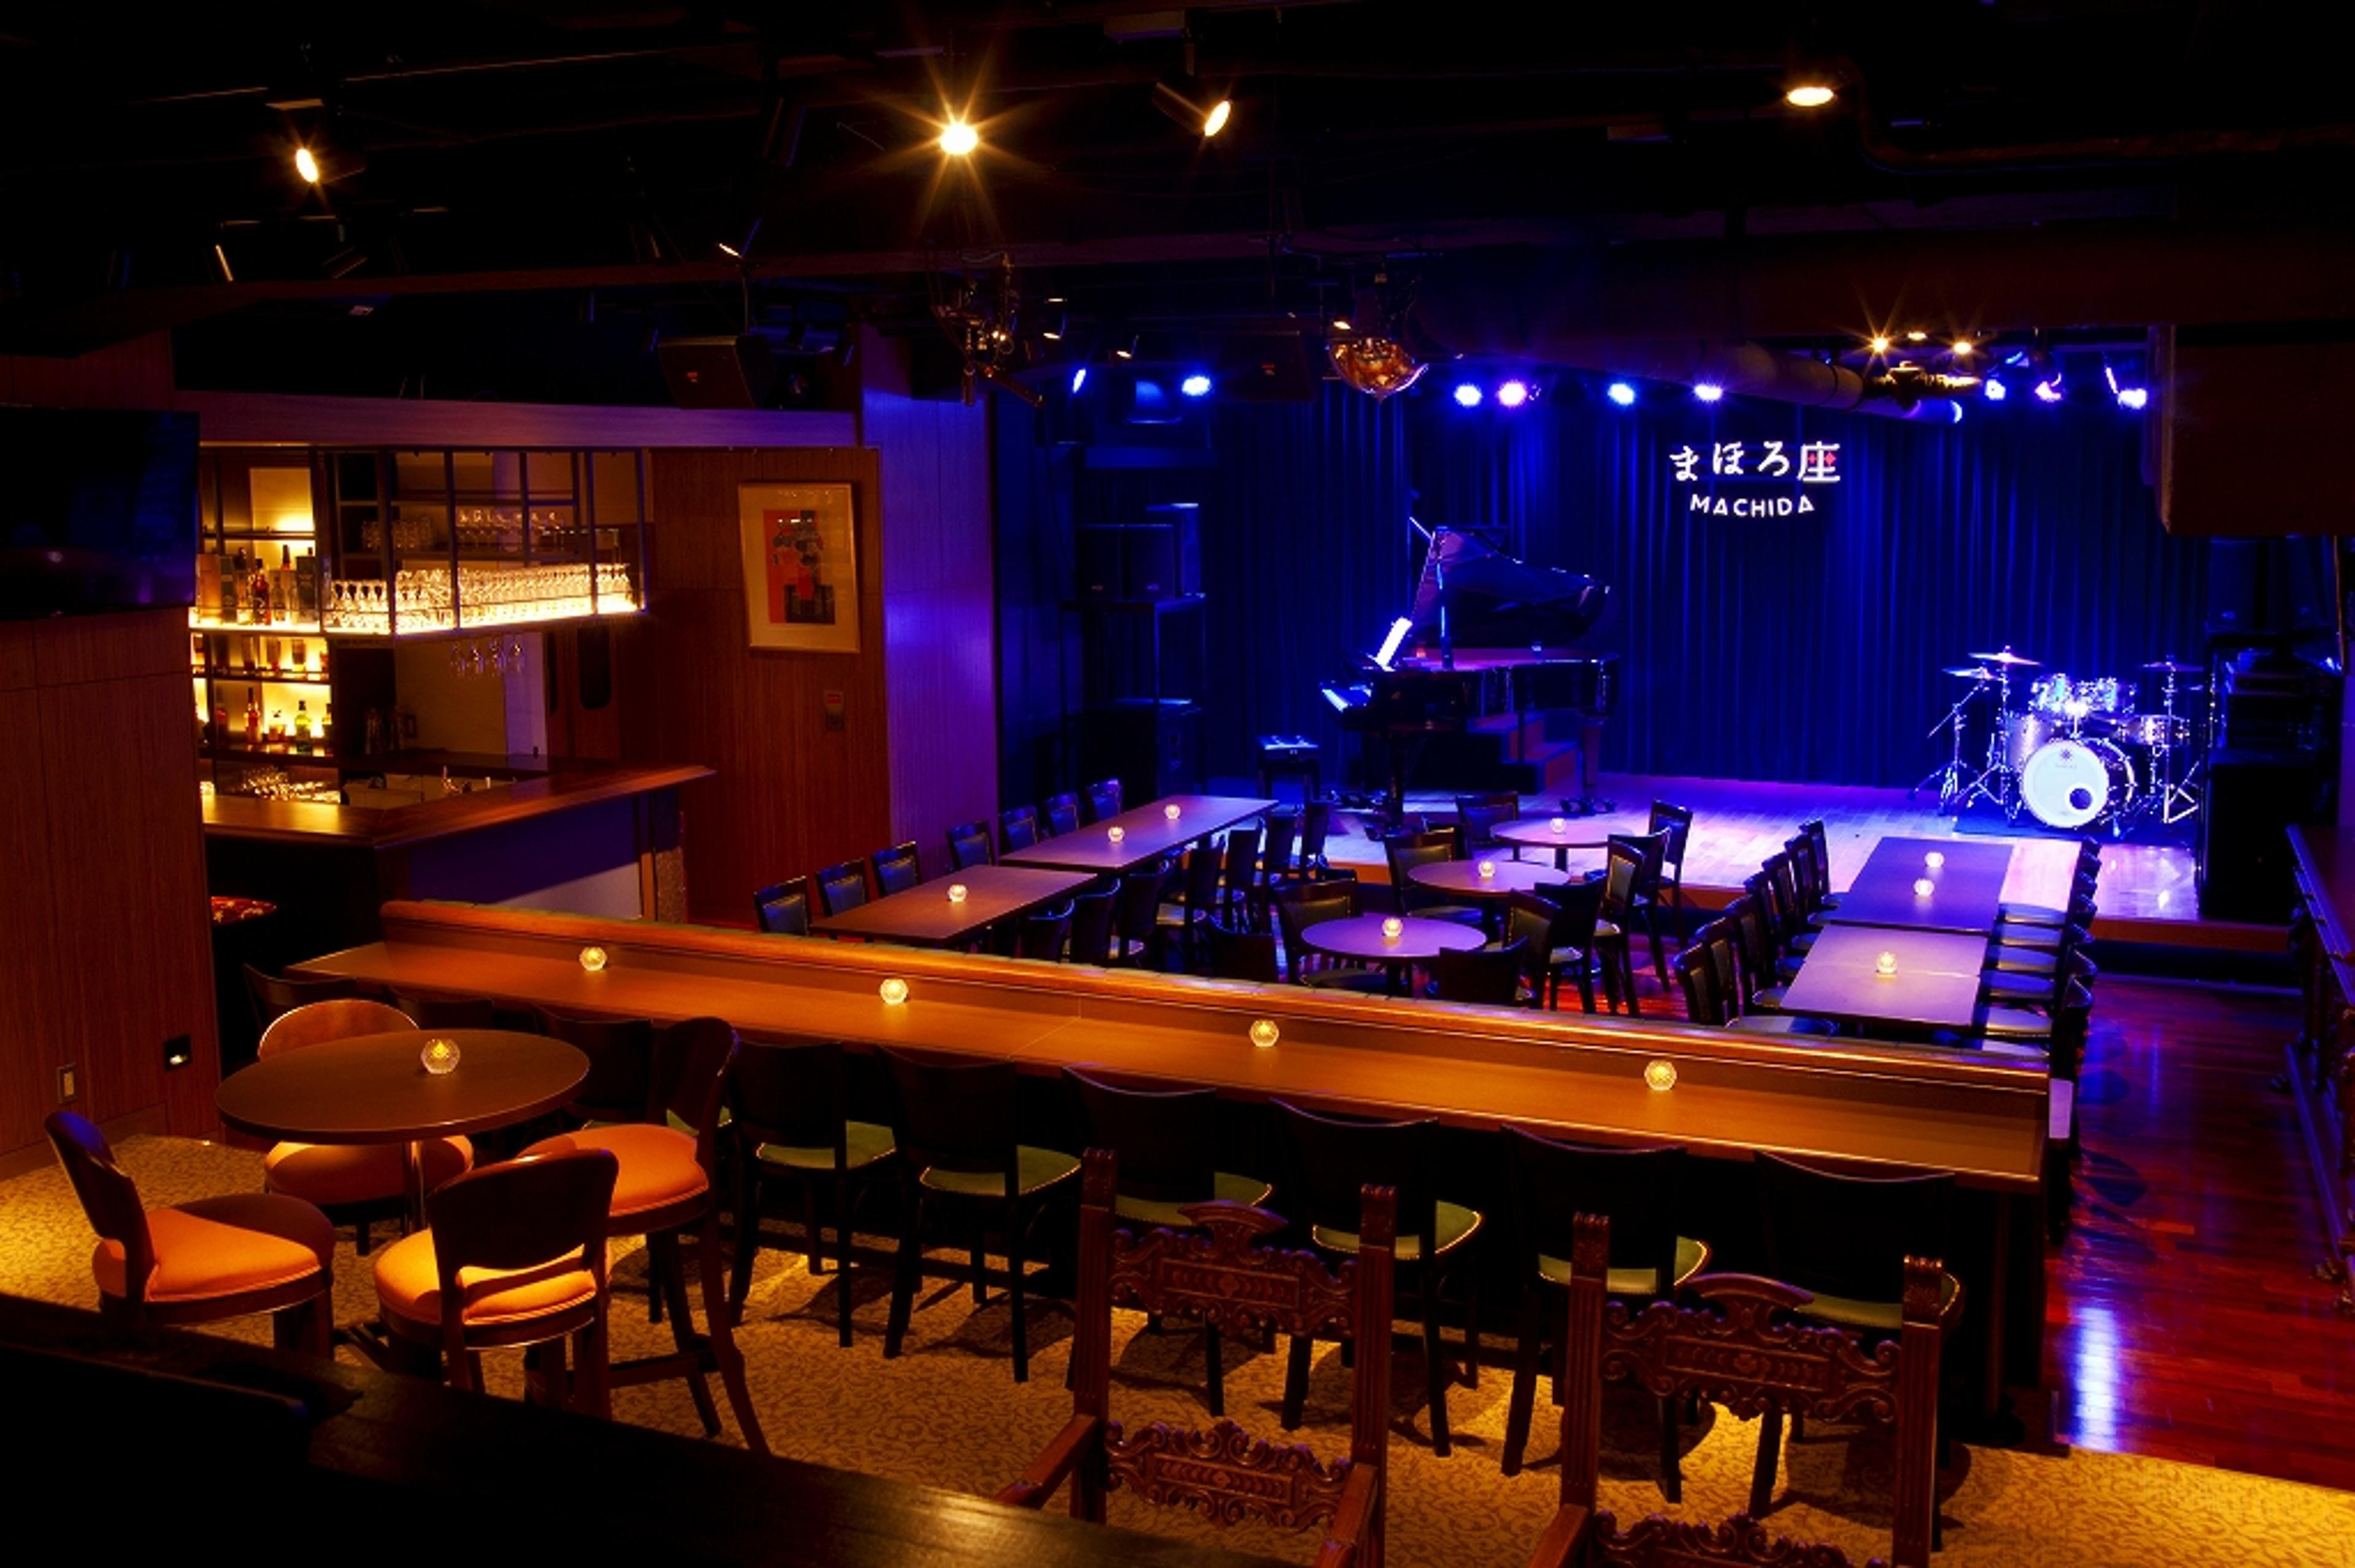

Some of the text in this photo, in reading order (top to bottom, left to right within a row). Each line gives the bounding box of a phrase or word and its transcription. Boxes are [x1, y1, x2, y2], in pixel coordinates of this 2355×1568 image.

[1669, 440, 1840, 483] まほろ座
[1689, 493, 1815, 518] MACHIDA
